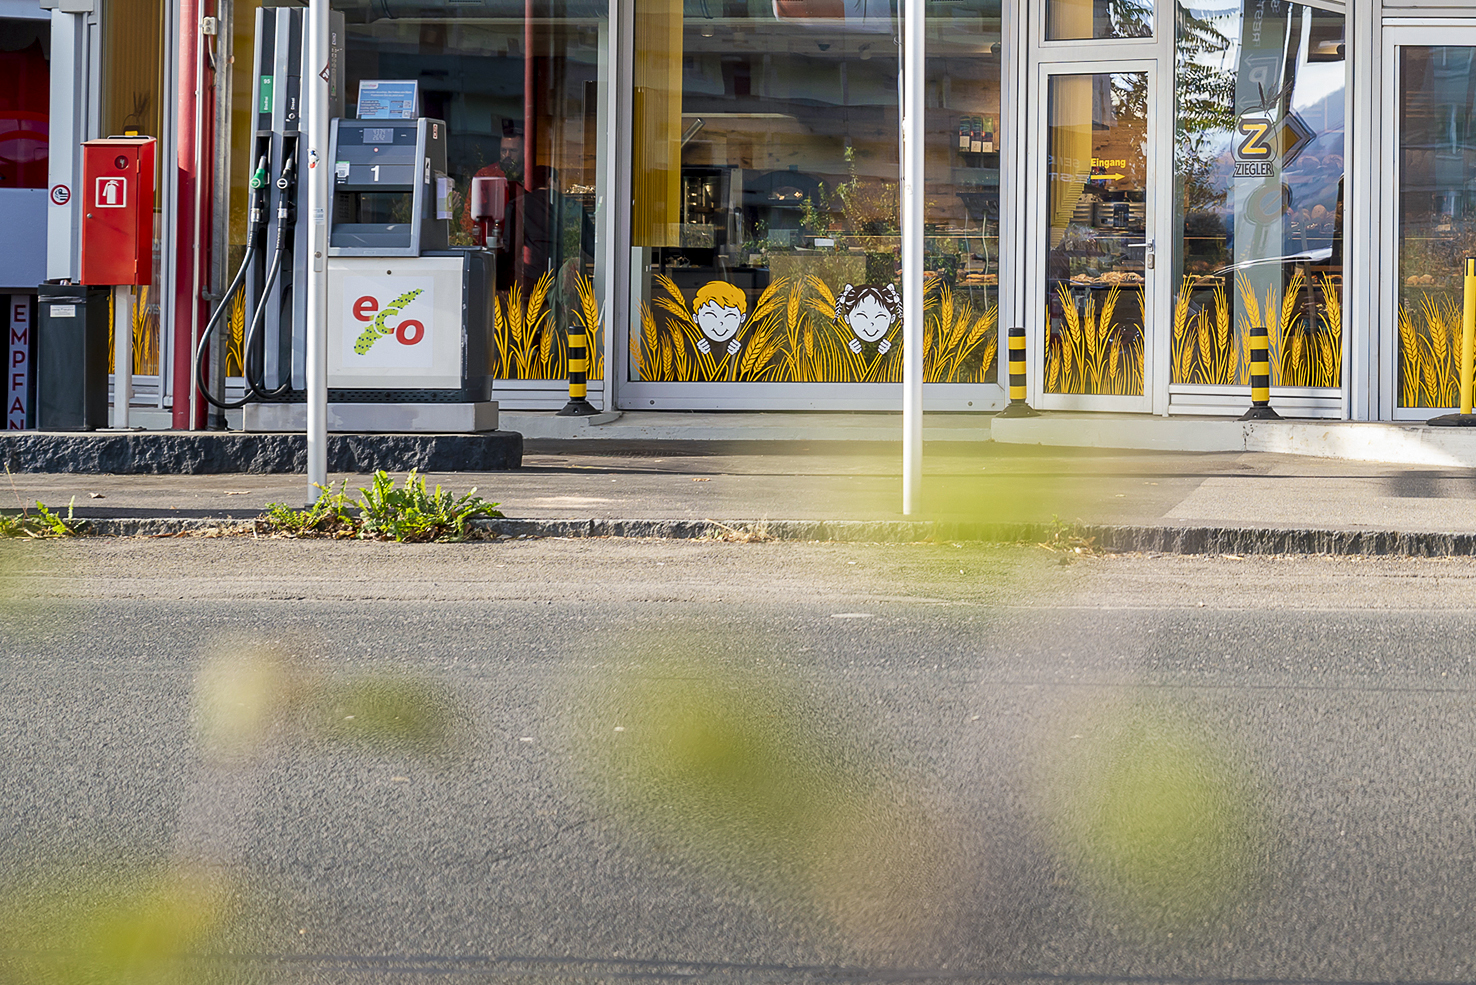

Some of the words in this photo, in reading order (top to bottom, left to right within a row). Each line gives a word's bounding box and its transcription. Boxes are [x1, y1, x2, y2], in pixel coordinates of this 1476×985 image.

[1091, 158, 1126, 168] Eingang
[1235, 163, 1272, 176] ZIEGLER
[370, 165, 380, 182] 1
